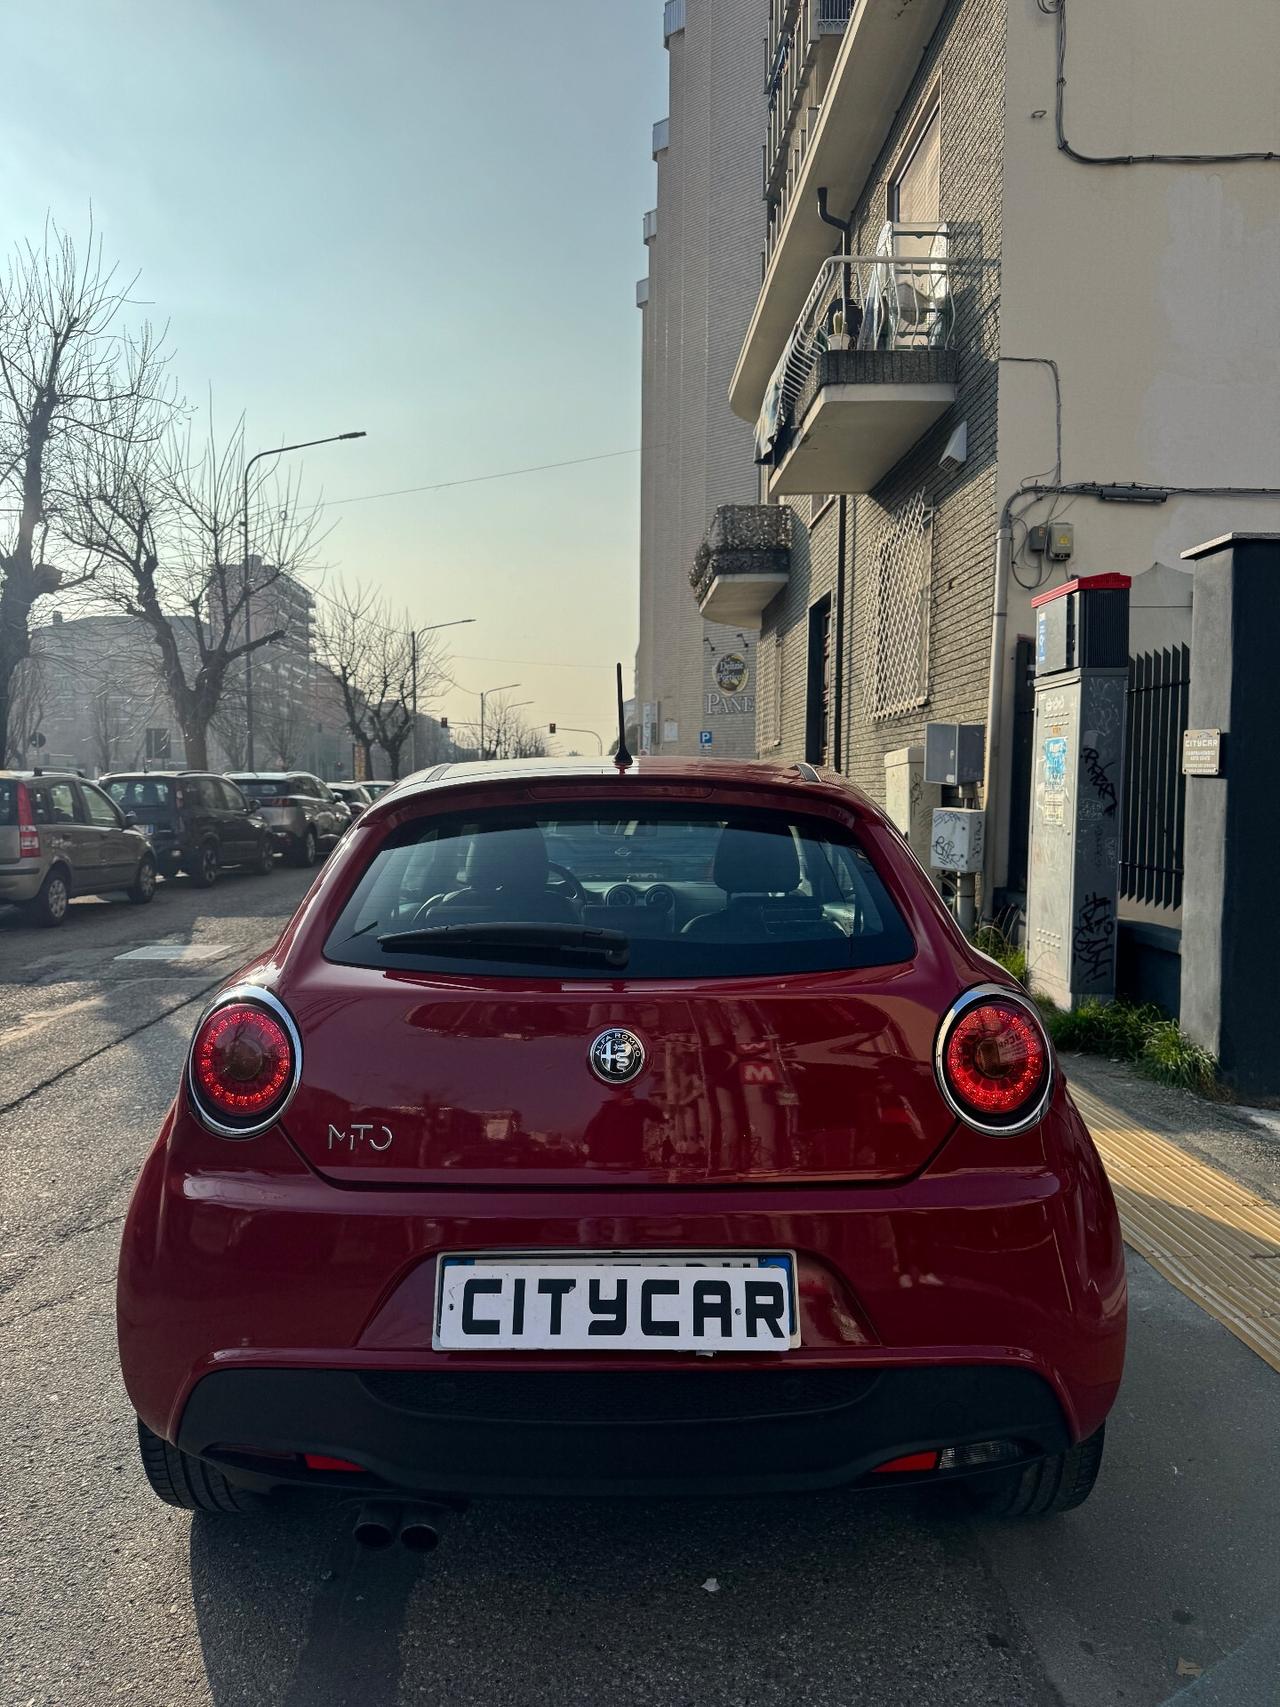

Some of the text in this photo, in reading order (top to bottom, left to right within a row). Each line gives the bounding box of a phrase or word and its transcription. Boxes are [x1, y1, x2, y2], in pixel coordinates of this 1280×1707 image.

[707, 693, 754, 714] PANE
[702, 732, 711, 743] P
[595, 1032, 641, 1057] ALFA ROMEO
[461, 1278, 786, 1339] CITYCAR
